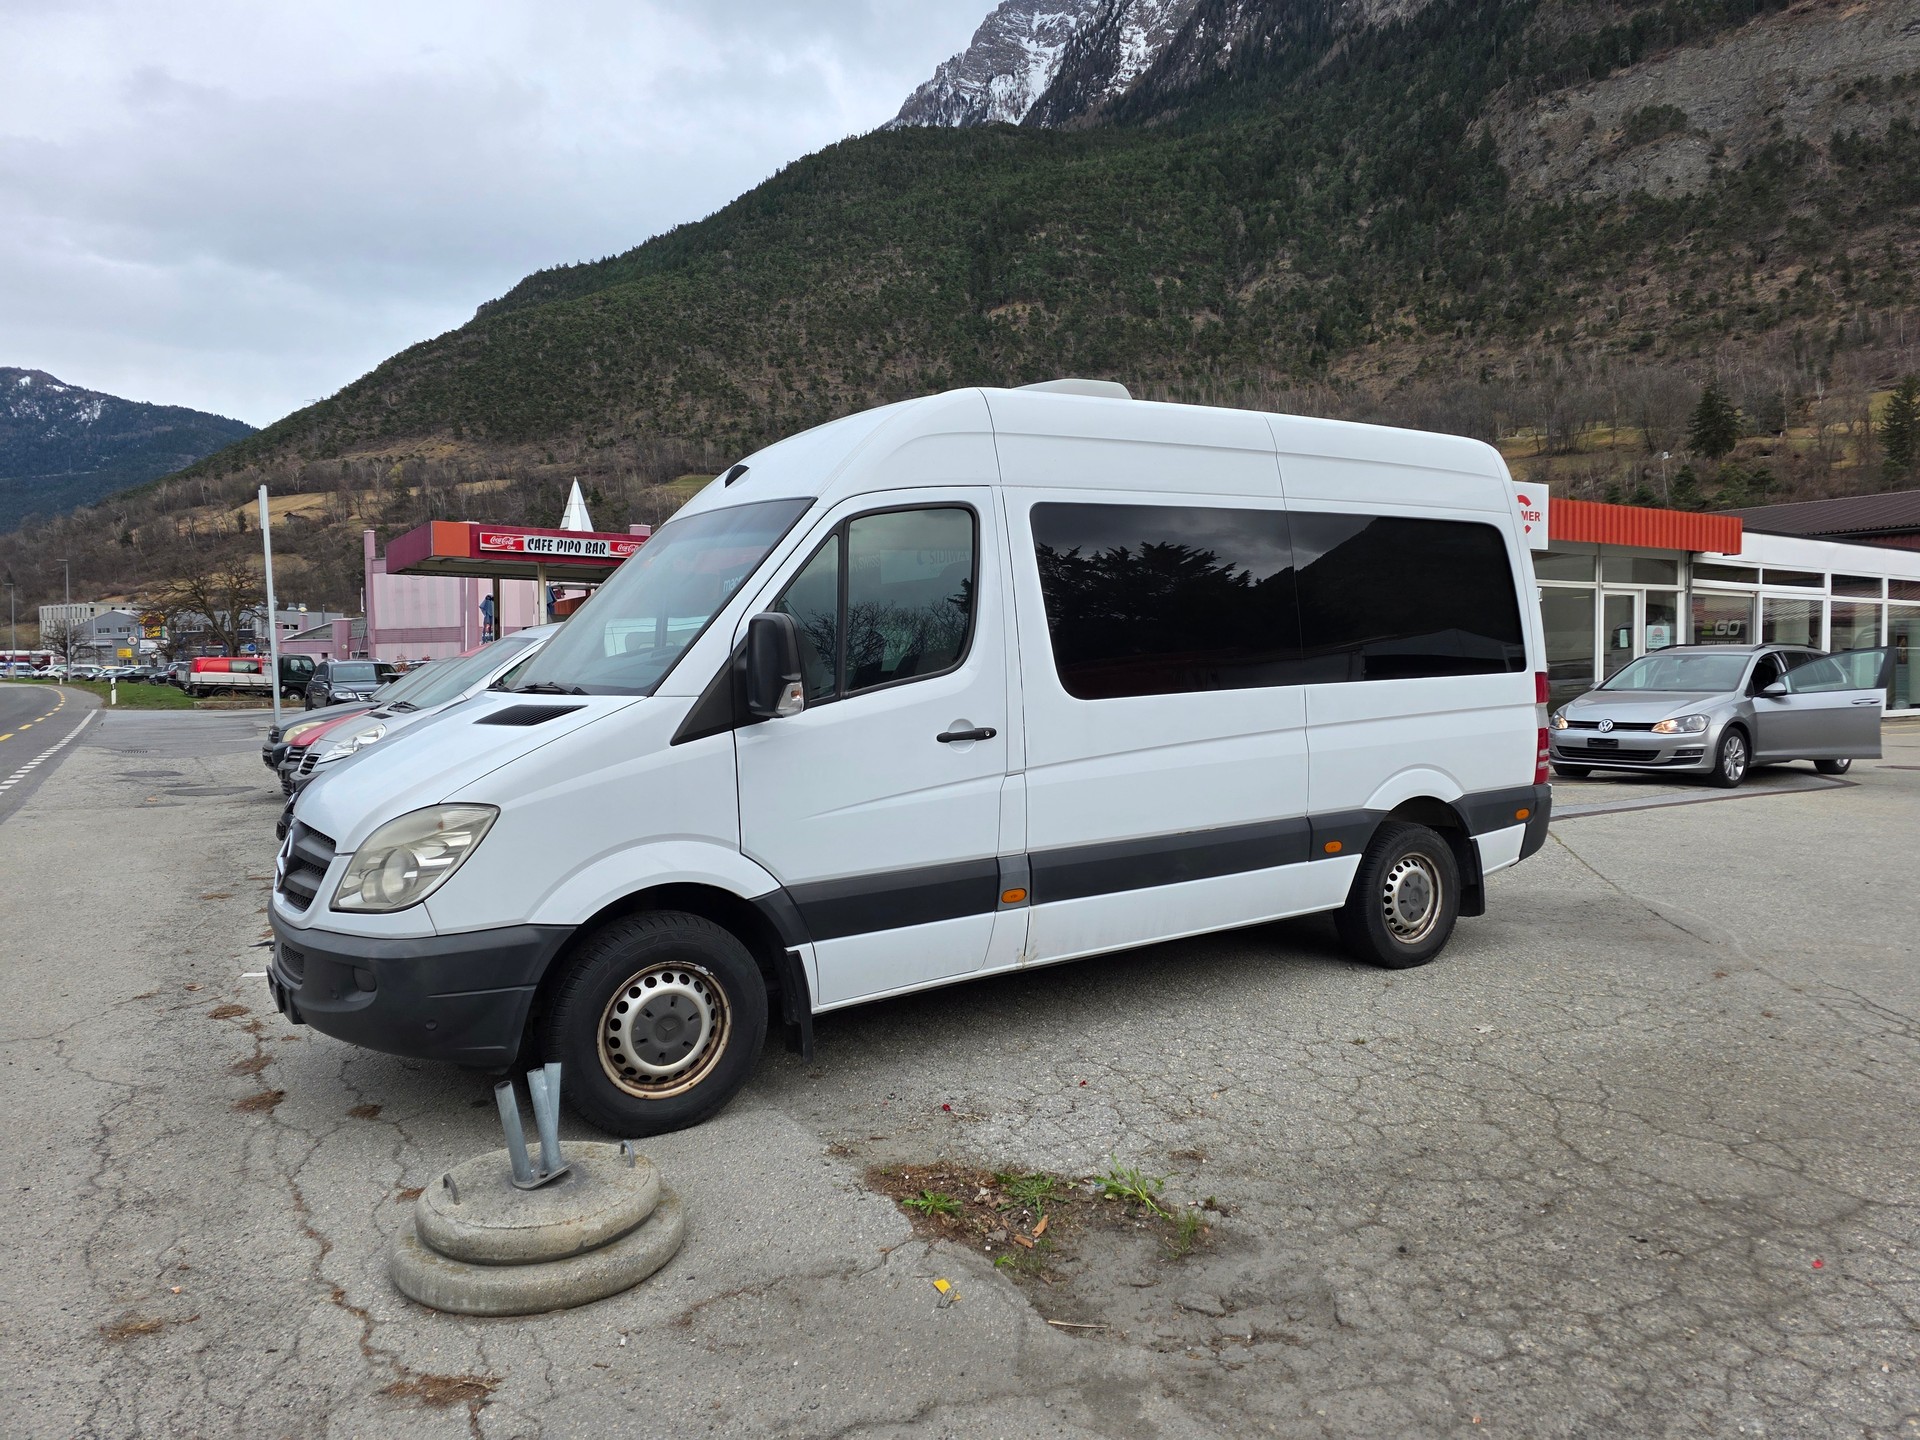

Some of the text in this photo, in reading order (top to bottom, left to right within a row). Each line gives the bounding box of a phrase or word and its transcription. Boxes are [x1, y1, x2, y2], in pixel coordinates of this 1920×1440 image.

[490, 536, 514, 545] Coca-Cola
[527, 537, 607, 555] CAFE PIPO BAR
